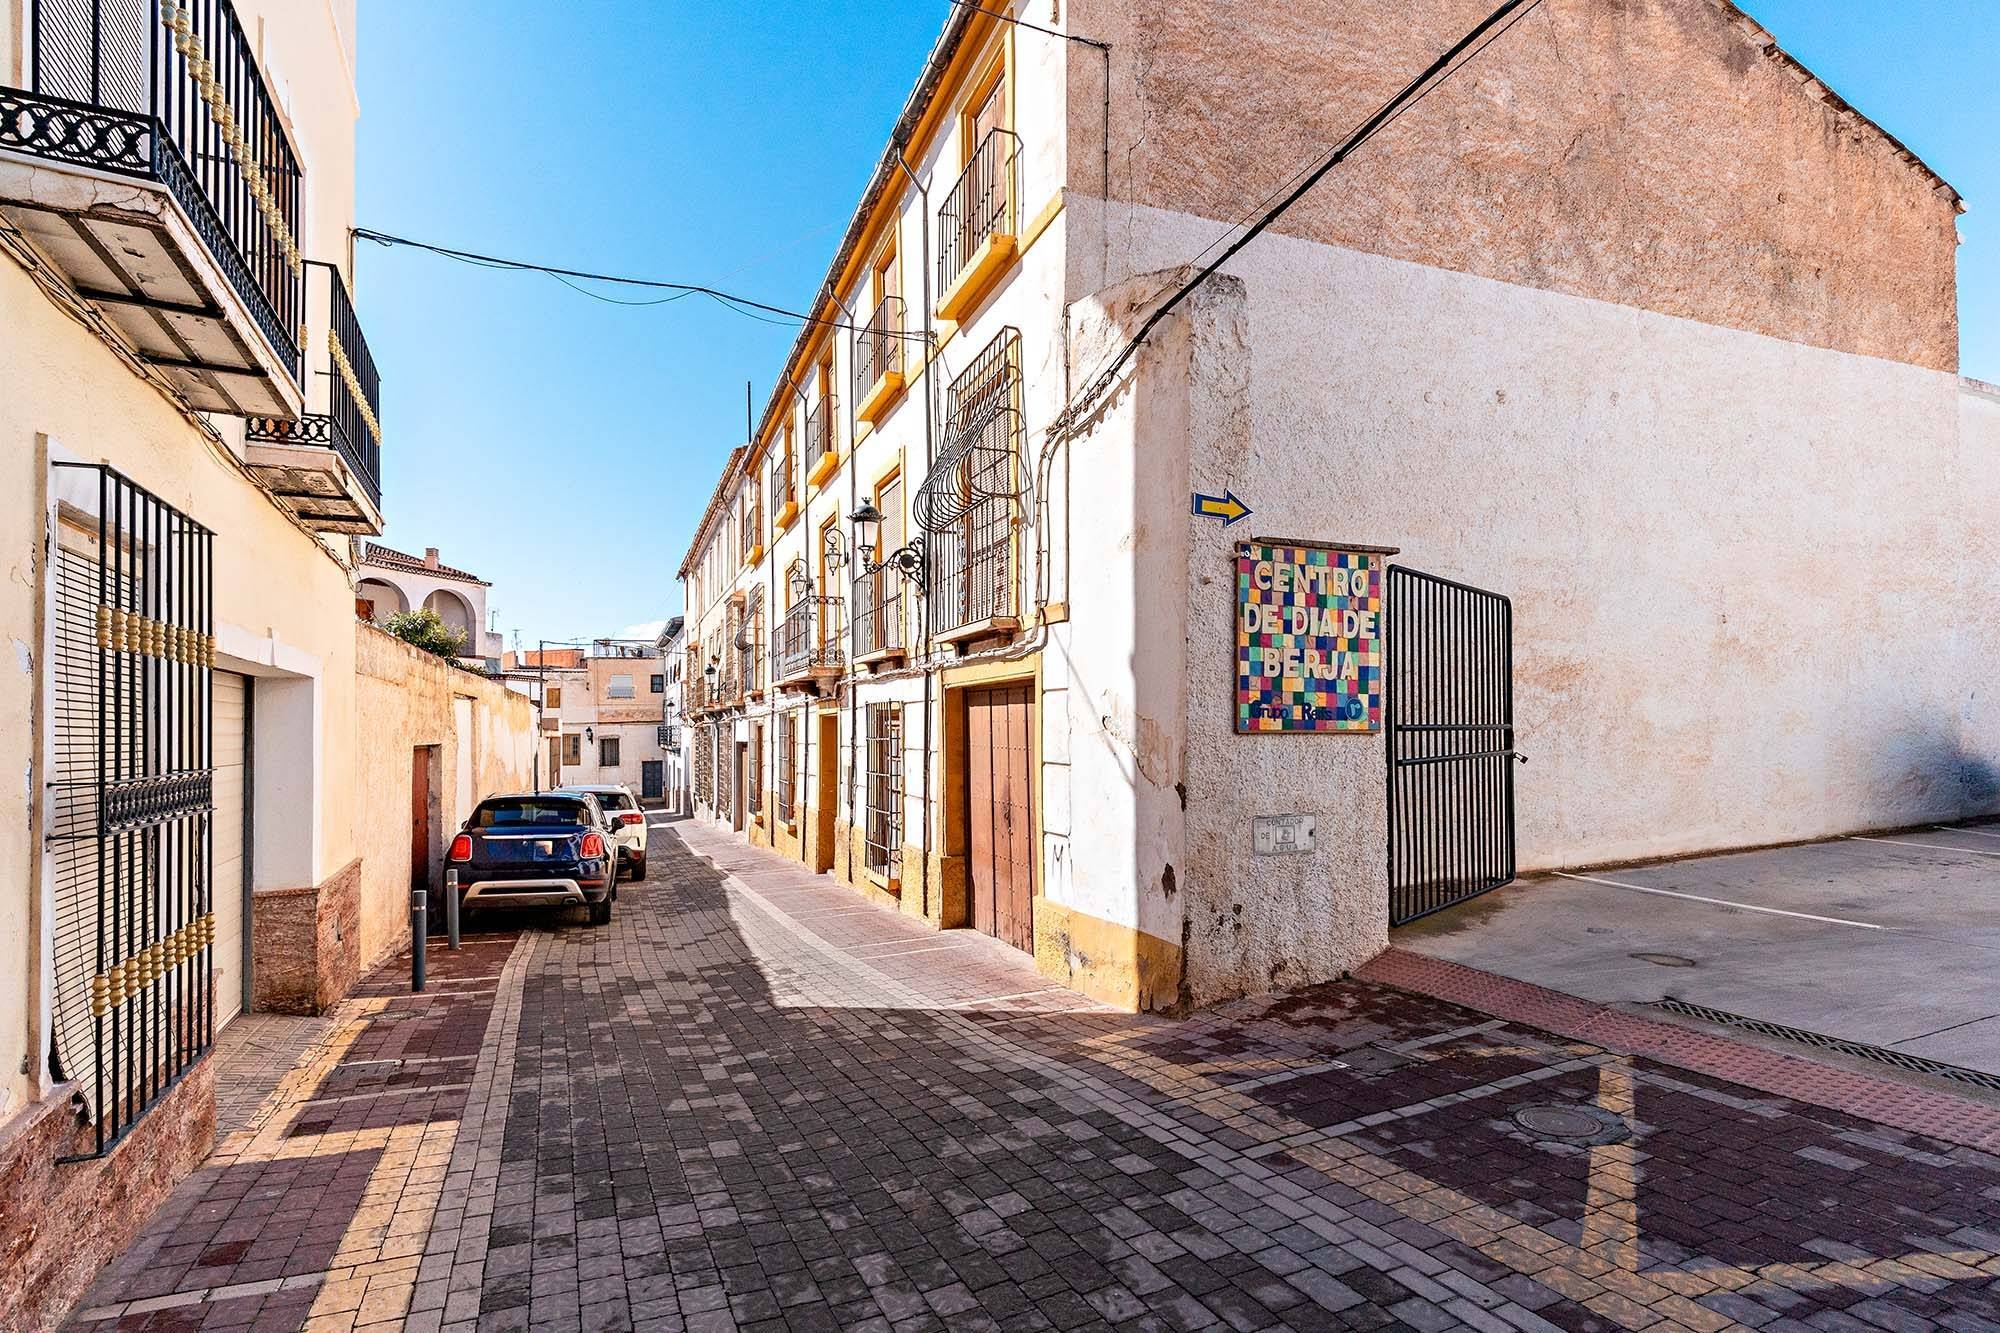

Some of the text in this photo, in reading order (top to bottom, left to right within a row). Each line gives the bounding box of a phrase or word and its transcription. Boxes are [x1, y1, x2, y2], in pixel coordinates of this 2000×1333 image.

[1254, 561, 1367, 597] CENTRO
[1244, 602, 1375, 639] DE DIA DE
[1263, 648, 1358, 680] BERJA
[1250, 699, 1289, 721] Grupo
[1266, 817, 1304, 827] CONTADOR
[1260, 831, 1271, 840] DE
[1271, 843, 1299, 852] AGUA
